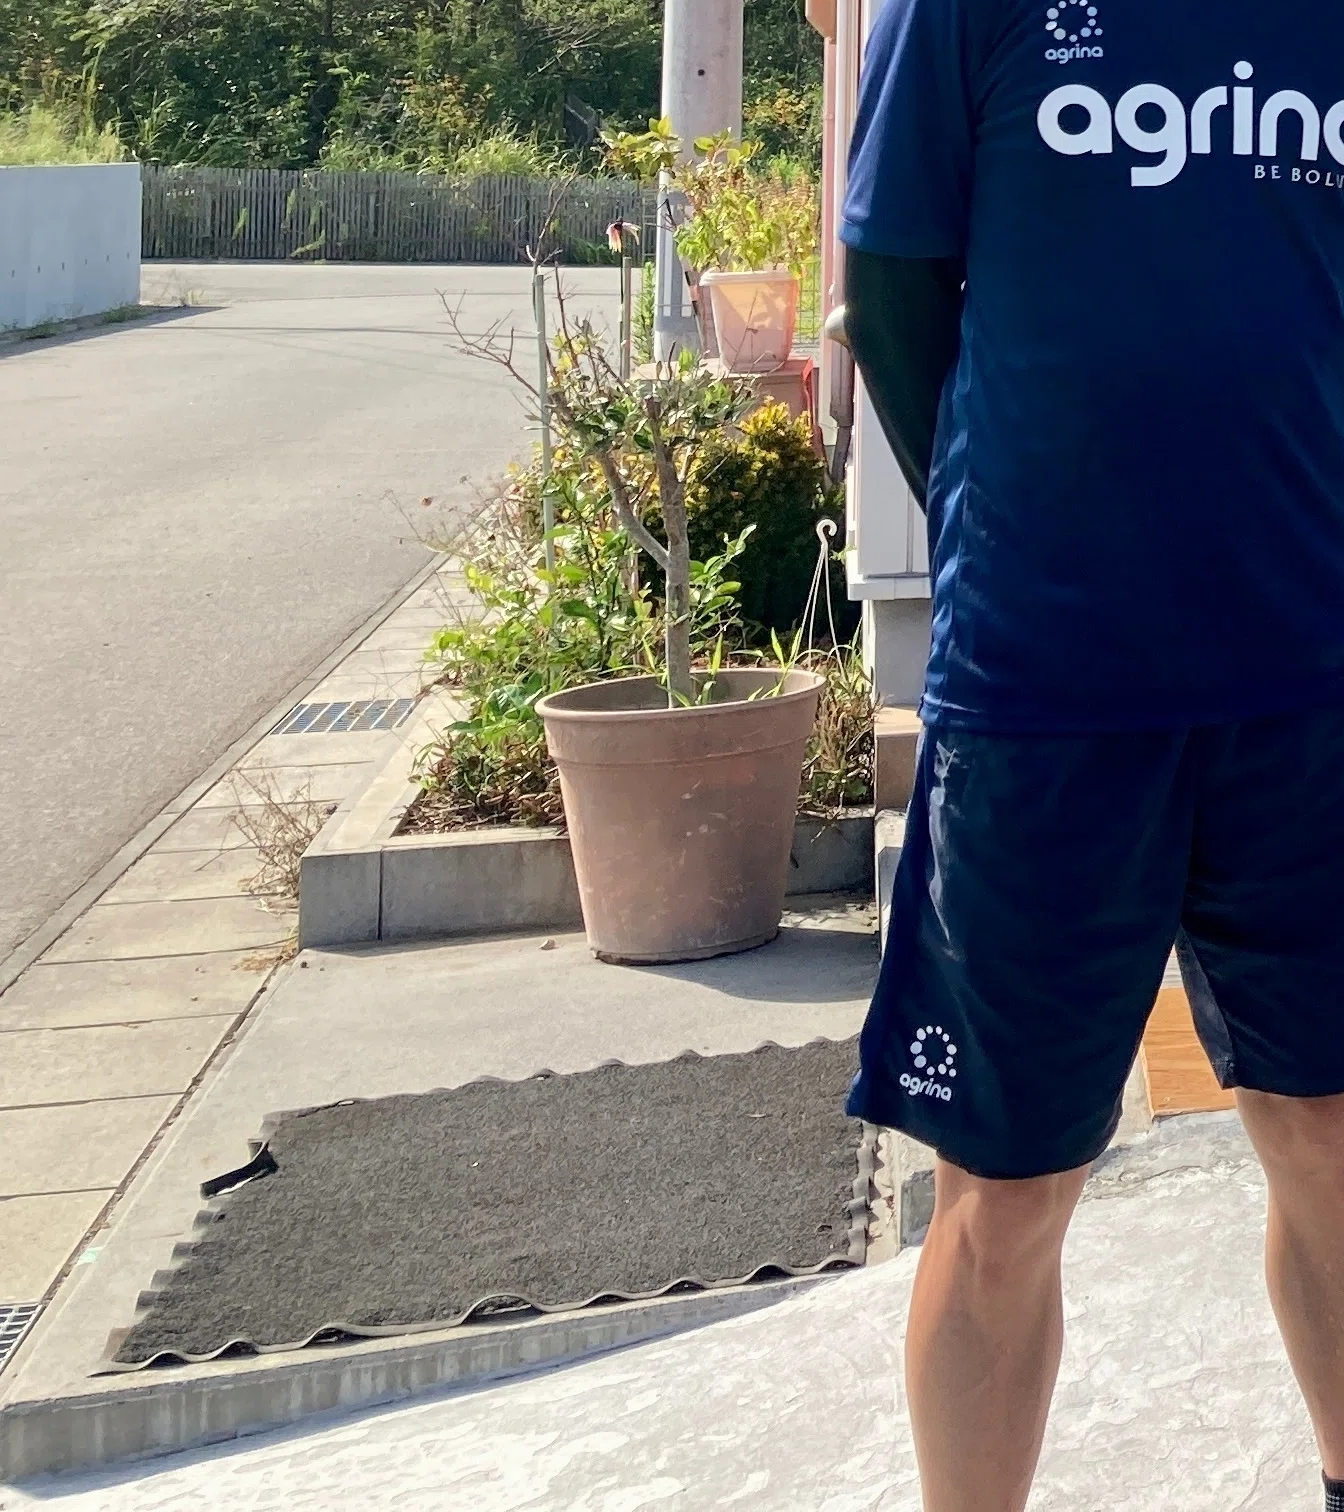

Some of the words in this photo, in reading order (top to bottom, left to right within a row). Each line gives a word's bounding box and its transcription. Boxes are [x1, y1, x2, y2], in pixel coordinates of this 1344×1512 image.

[1044, 43, 1104, 65] agrina
[1254, 164, 1282, 180] BE
[899, 1072, 952, 1101] agrina
